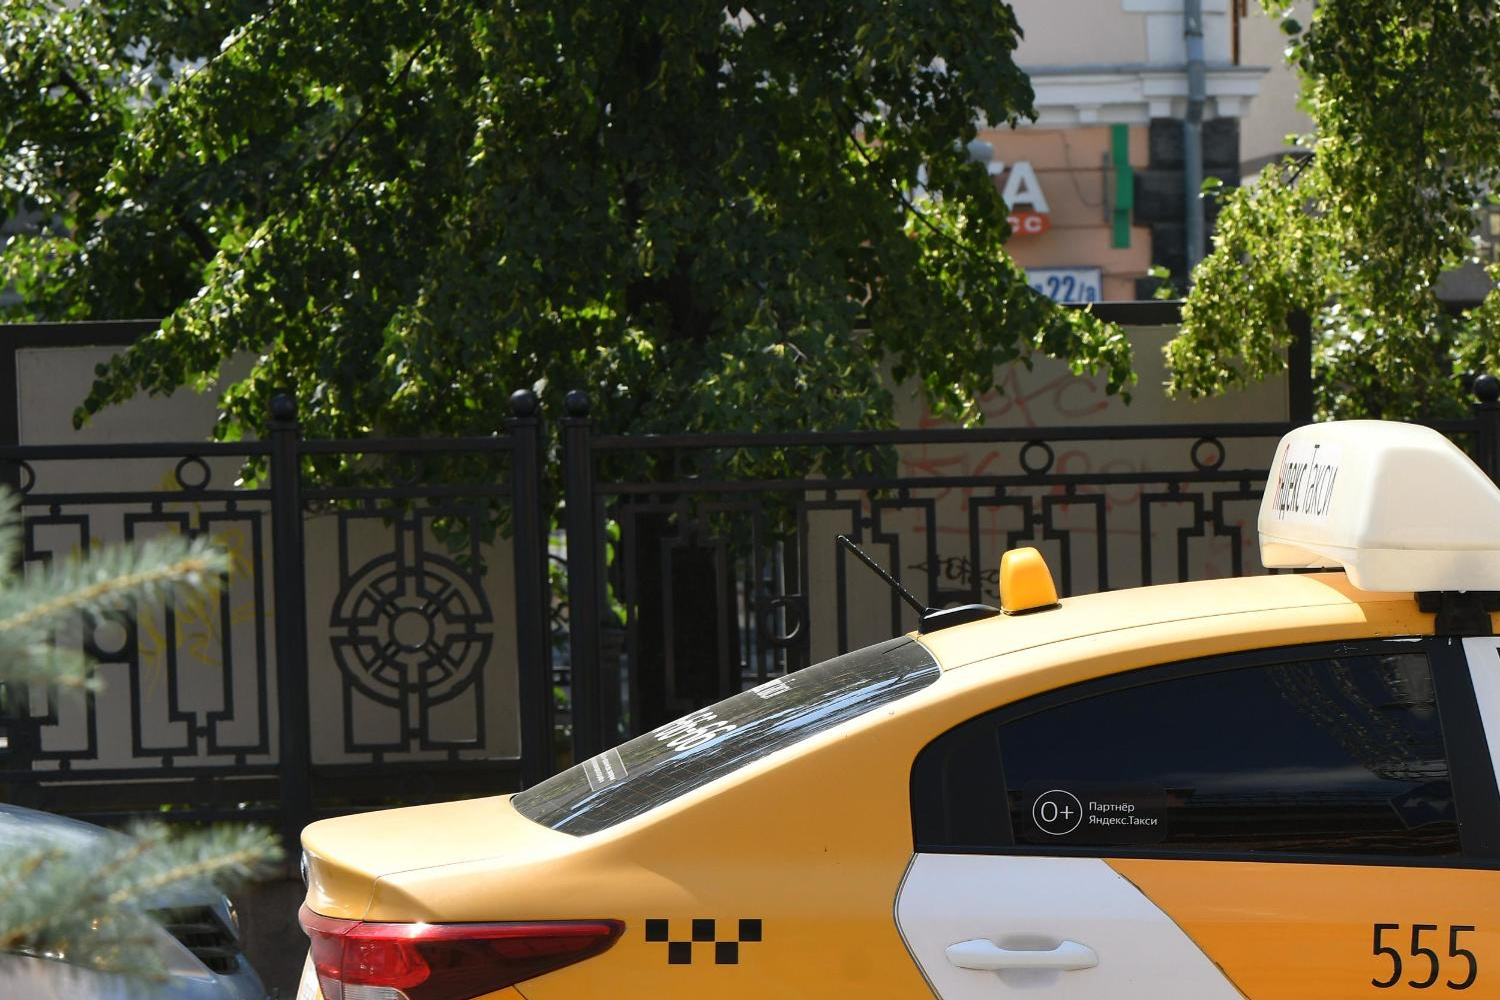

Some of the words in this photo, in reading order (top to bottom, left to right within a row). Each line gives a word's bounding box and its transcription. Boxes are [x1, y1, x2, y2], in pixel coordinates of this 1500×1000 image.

[1272, 443, 1308, 520] Яндекс
[1301, 444, 1339, 516] Такси
[1088, 801, 1135, 814] Партнёр
[1088, 815, 1158, 827] Яндекс.Такси
[1371, 923, 1478, 991] 555
